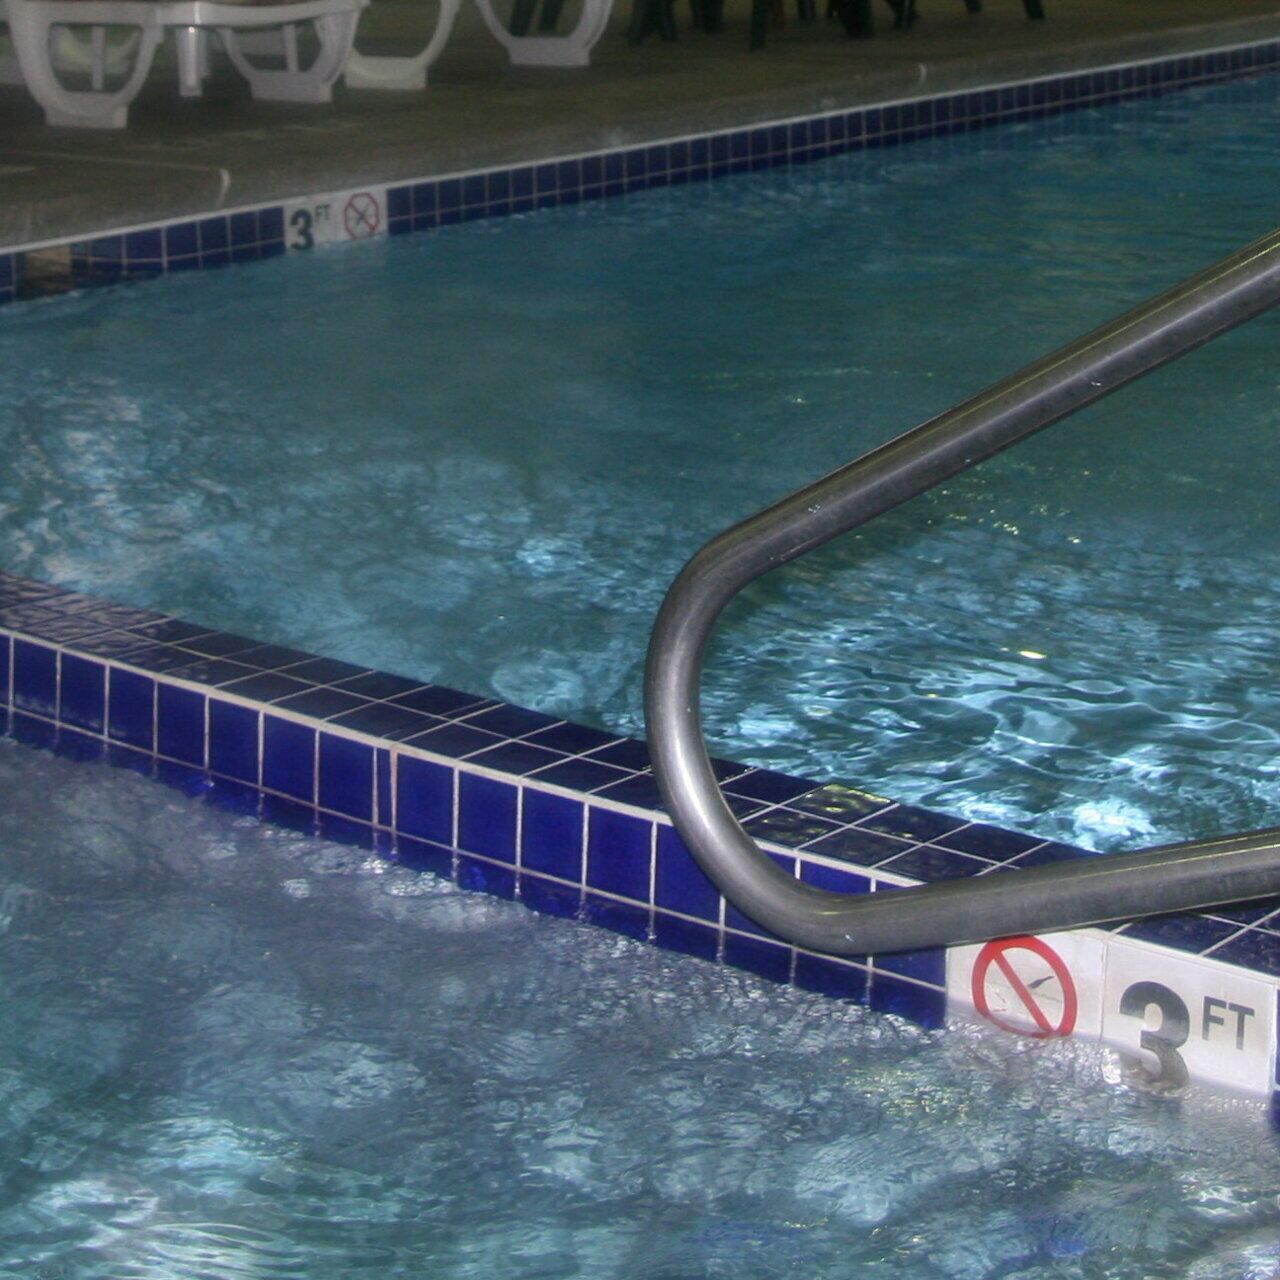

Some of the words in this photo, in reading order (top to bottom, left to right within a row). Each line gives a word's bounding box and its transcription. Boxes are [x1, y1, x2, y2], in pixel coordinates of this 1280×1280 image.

[290, 208, 315, 251] 3
[1120, 981, 1190, 1087] 3
[1202, 996, 1255, 1050] FT
